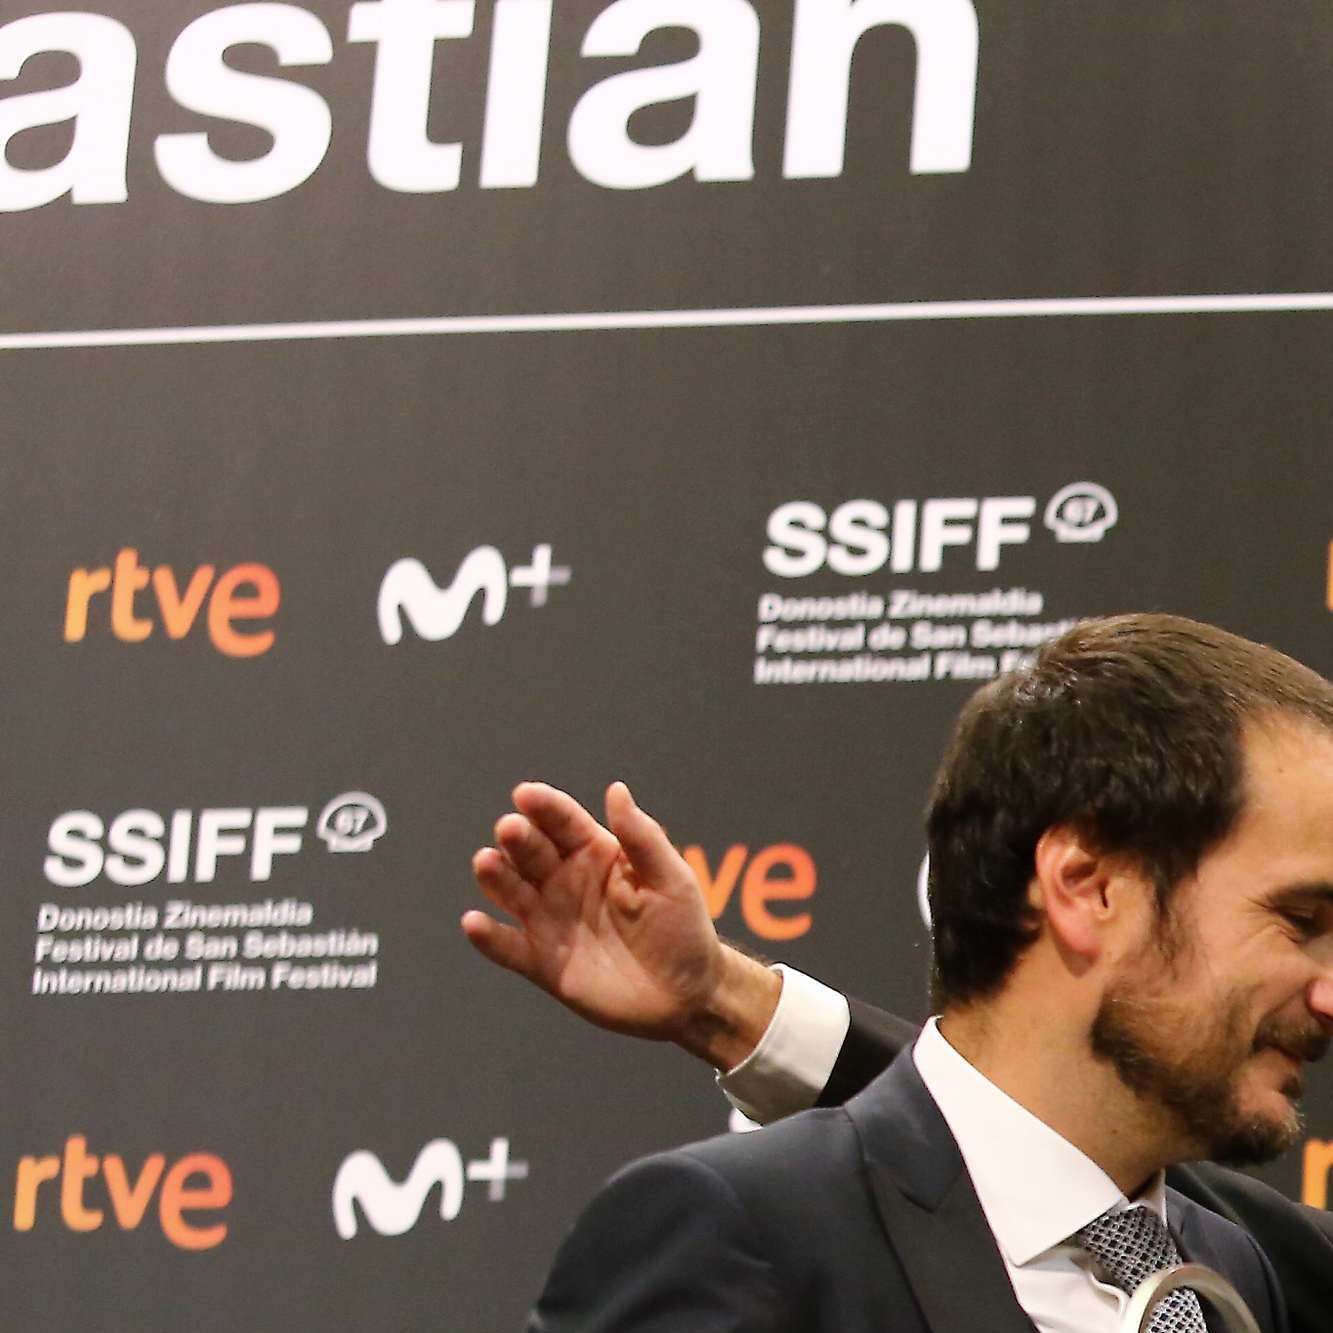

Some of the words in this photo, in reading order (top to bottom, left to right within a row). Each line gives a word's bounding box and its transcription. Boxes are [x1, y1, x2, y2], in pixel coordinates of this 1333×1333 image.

[762, 496, 1036, 578] SSIFF
[64, 547, 280, 658] rtve
[758, 593, 884, 622] Donostia
[888, 590, 1043, 618] Zinemaldia
[756, 624, 865, 653] Festival
[867, 623, 907, 651] de
[910, 620, 967, 650] San
[754, 654, 930, 684] International
[933, 651, 996, 680] Film
[43, 805, 309, 888] SSIFF
[681, 842, 816, 941] ve
[37, 901, 157, 932] Donostia
[162, 898, 313, 929] Zinemaldia
[34, 932, 139, 963] Festival
[144, 932, 178, 960] de
[184, 930, 238, 960] San
[32, 963, 201, 995] International
[207, 962, 266, 992] Film
[270, 959, 378, 990] Festival
[12, 1133, 233, 1250] rtve
